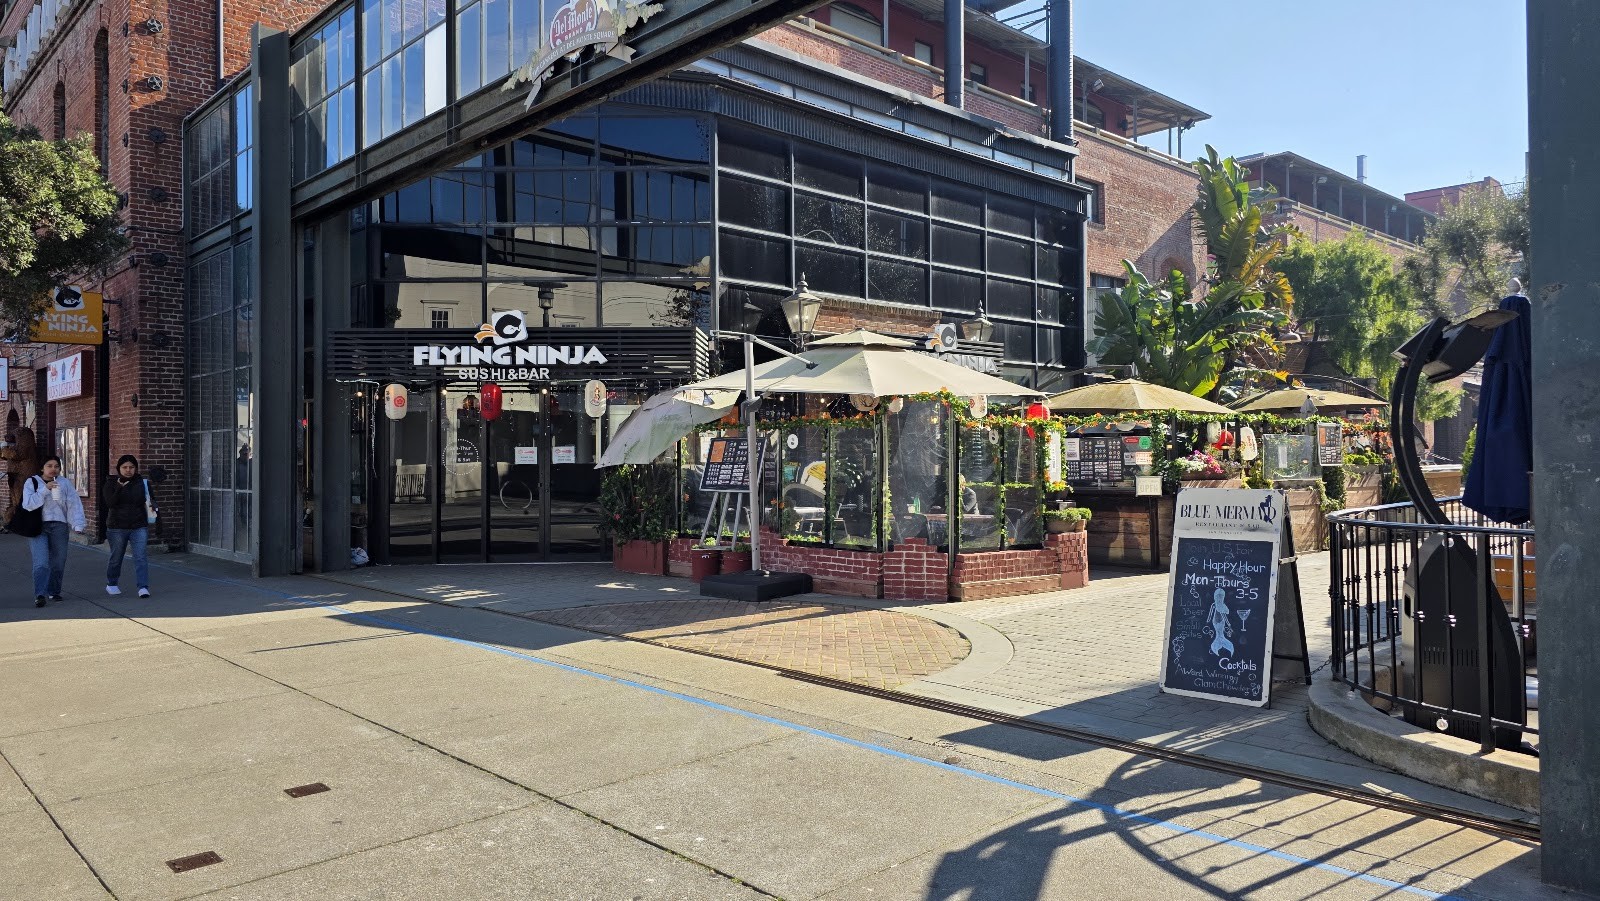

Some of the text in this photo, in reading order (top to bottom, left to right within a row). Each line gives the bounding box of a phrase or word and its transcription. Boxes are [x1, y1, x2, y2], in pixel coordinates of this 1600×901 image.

[554, 2, 593, 37] Del Monte
[48, 322, 98, 333] NINJA
[413, 345, 609, 366] FLYING NINJA
[1139, 484, 1158, 493] OPEN
[1180, 504, 1277, 520] BLUE MERMAD
[1203, 558, 1266, 574] Happy Hour
[1235, 587, 1260, 600] 3-5
[1183, 607, 1206, 616] Beer
[1218, 657, 1257, 671] Cocktails
